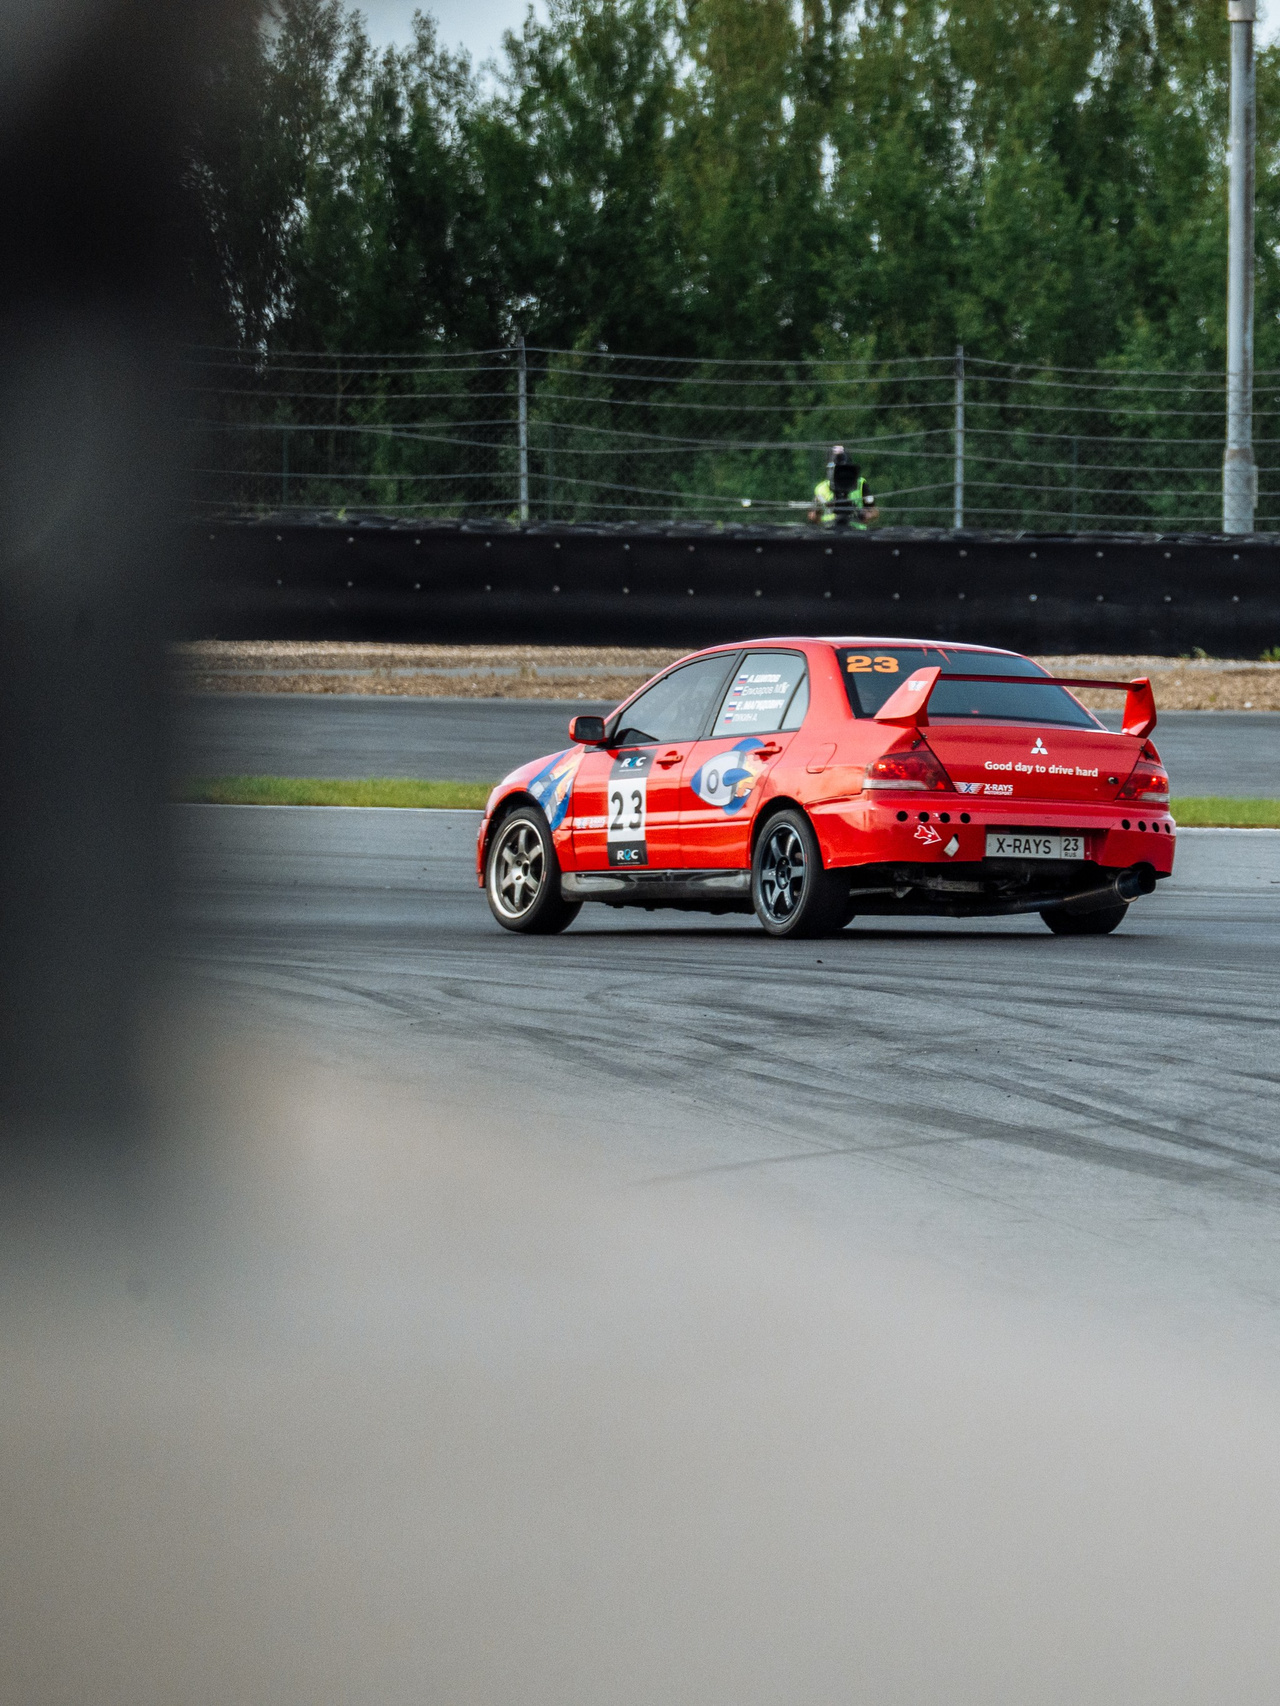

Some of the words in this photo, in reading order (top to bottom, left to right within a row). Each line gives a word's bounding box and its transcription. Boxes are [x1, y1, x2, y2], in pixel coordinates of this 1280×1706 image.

[846, 655, 900, 673] 23
[984, 761, 1013, 771] Good
[1014, 762, 1033, 774] day
[1036, 765, 1046, 773] to
[1048, 765, 1074, 775] drive
[1075, 766, 1099, 777] hard
[984, 783, 1014, 792] X-RAYS
[611, 790, 642, 832] 23
[996, 838, 1051, 855] X-RAYS
[1063, 838, 1079, 852] 23
